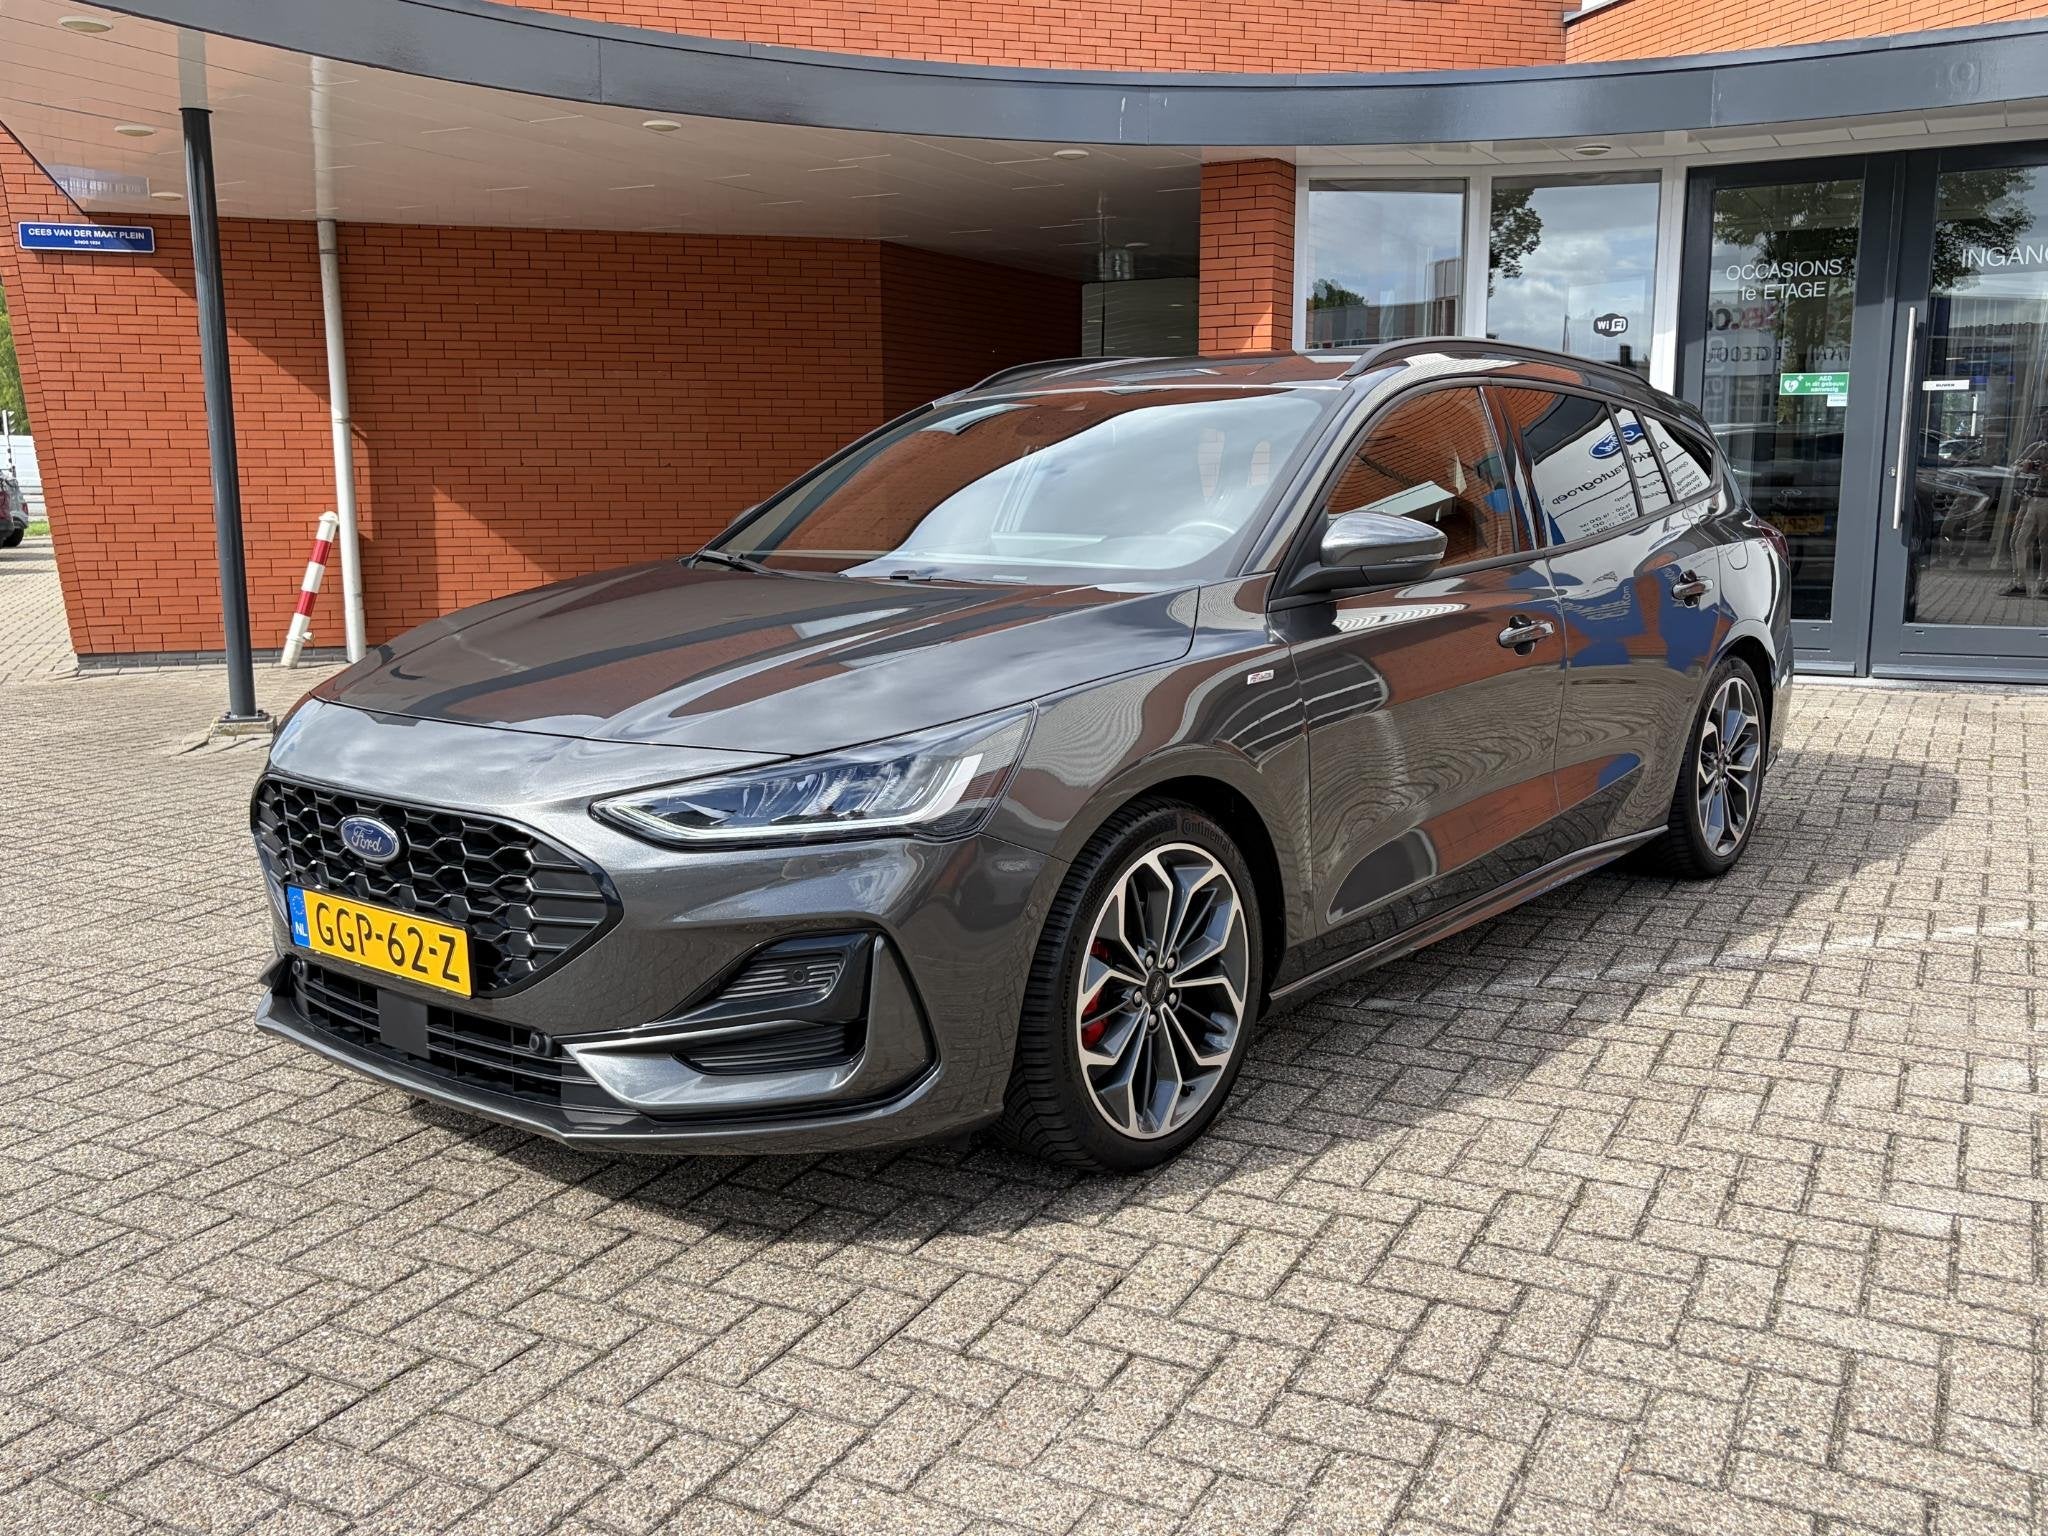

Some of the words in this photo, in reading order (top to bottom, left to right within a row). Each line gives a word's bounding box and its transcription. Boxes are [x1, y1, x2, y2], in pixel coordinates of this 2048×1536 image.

[28, 228, 52, 236] CEES
[53, 229, 72, 237] VAN
[74, 230, 92, 238] DER
[93, 230, 118, 239] MAAT
[120, 231, 145, 240] PLEIN
[1961, 244, 2048, 268] INGAN
[1726, 258, 1842, 281] OCCASIONS
[1740, 286, 1757, 301] 1e
[1764, 281, 1827, 300] ETAGE
[351, 825, 382, 853] Ford
[294, 921, 308, 938] NL
[315, 902, 461, 984] GGP-62-Z
